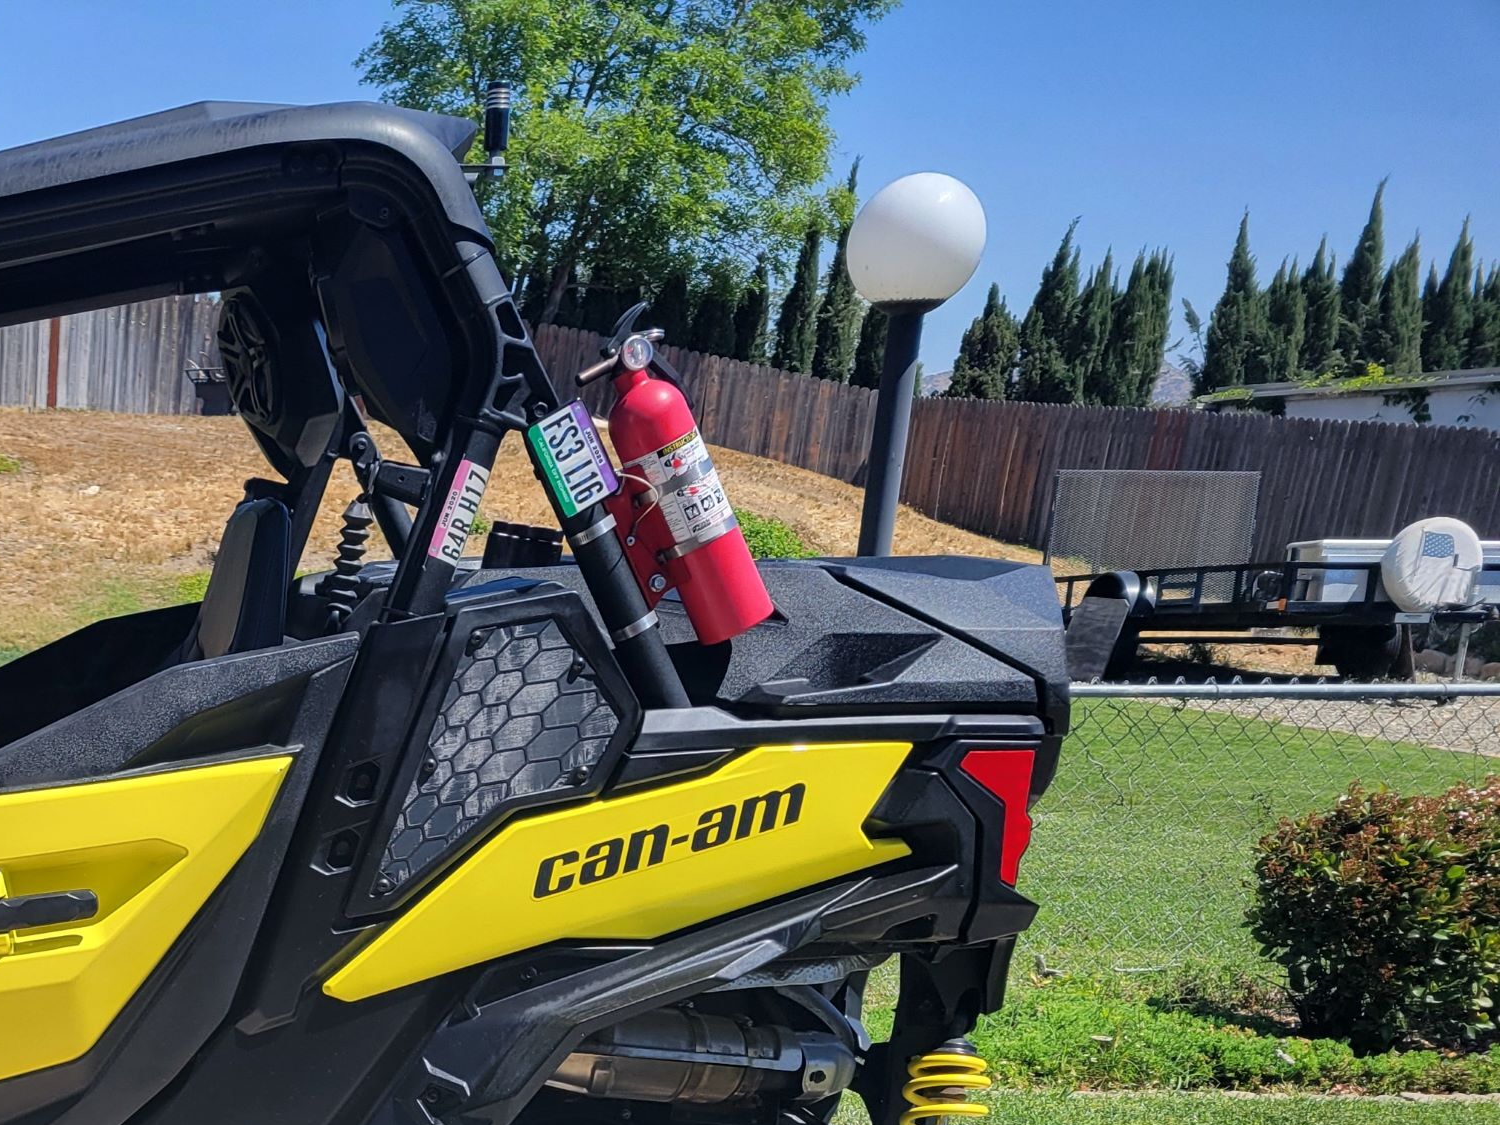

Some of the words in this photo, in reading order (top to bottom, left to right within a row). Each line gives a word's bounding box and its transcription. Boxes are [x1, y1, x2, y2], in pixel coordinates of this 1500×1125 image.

[543, 412, 585, 462] FS3
[564, 459, 604, 504] L16
[441, 513, 450, 527] JUN
[448, 491, 458, 510] 2020
[442, 518, 471, 561] 64R
[458, 470, 487, 514] H17
[533, 782, 806, 899] can-am
